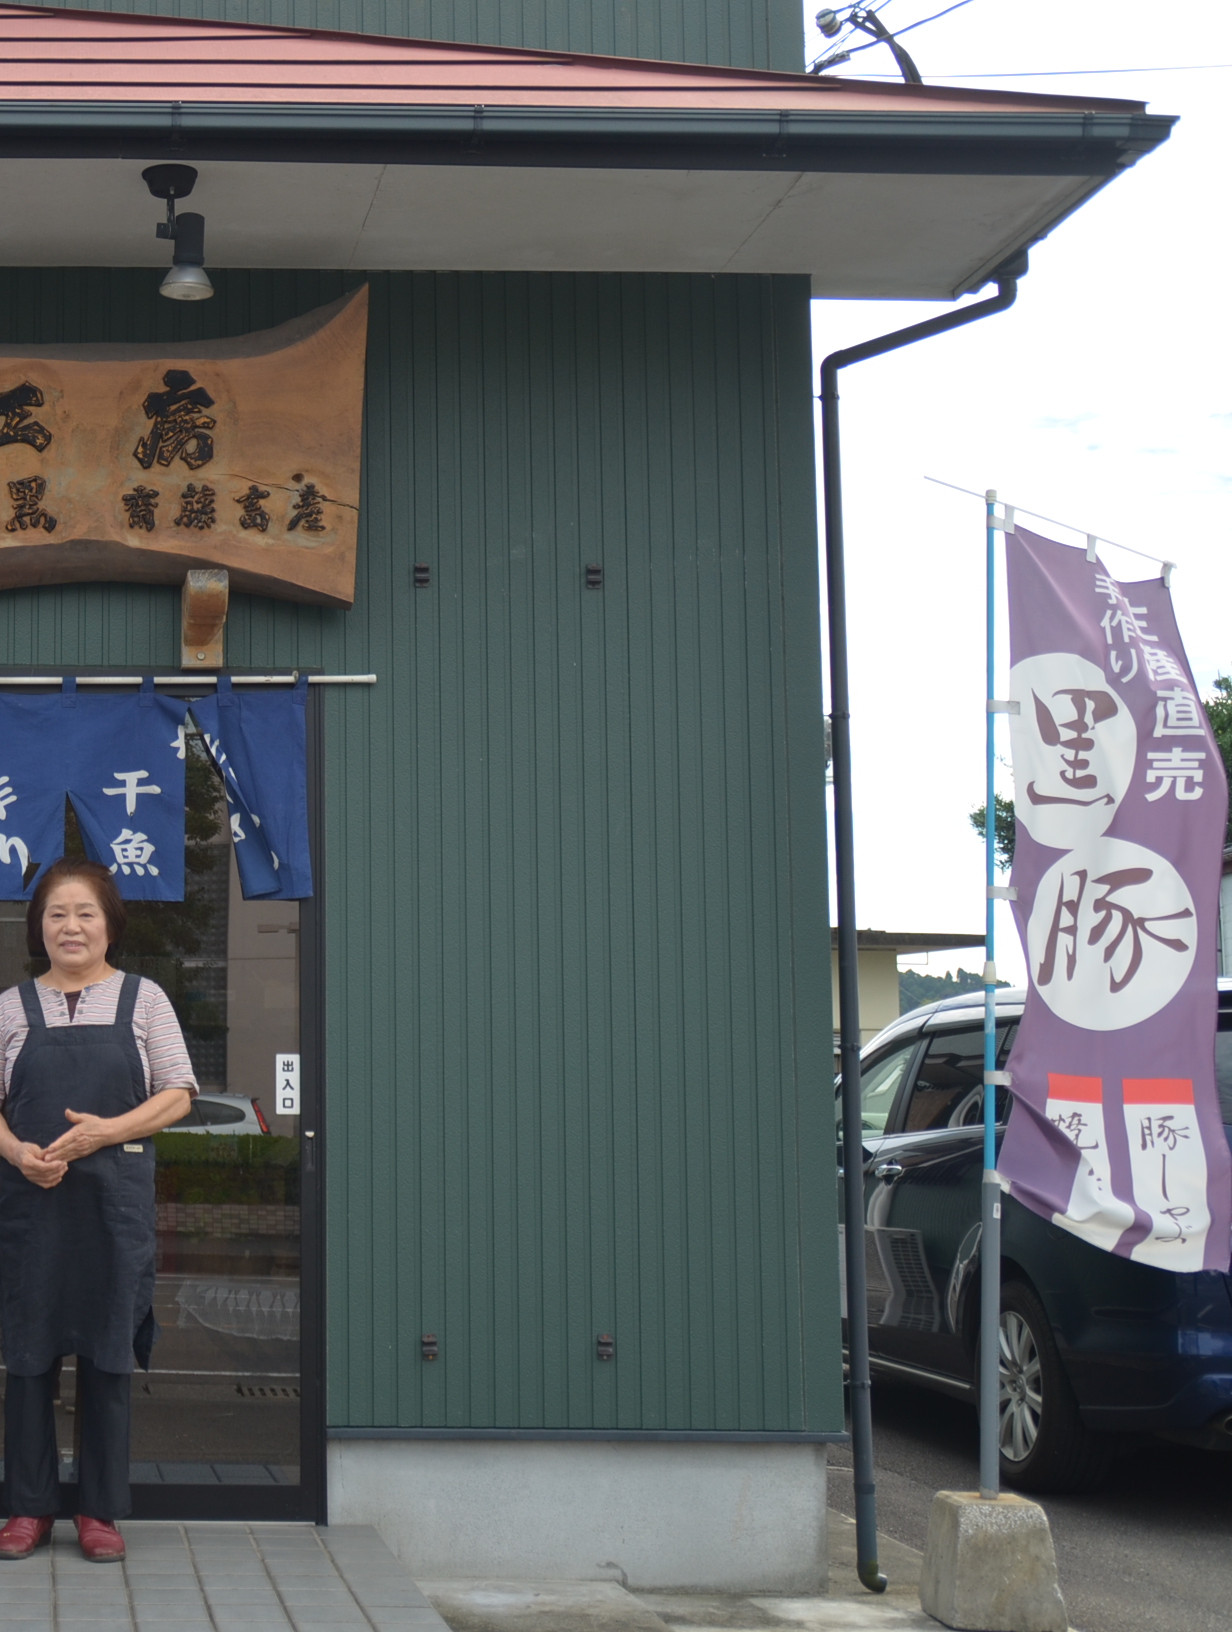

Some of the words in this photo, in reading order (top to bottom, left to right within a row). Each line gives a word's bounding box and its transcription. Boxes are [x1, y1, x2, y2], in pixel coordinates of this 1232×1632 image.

[1095, 574, 1138, 683] 手作り
[102, 769, 161, 877] 干魚
[282, 1059, 295, 1109] 出入口
